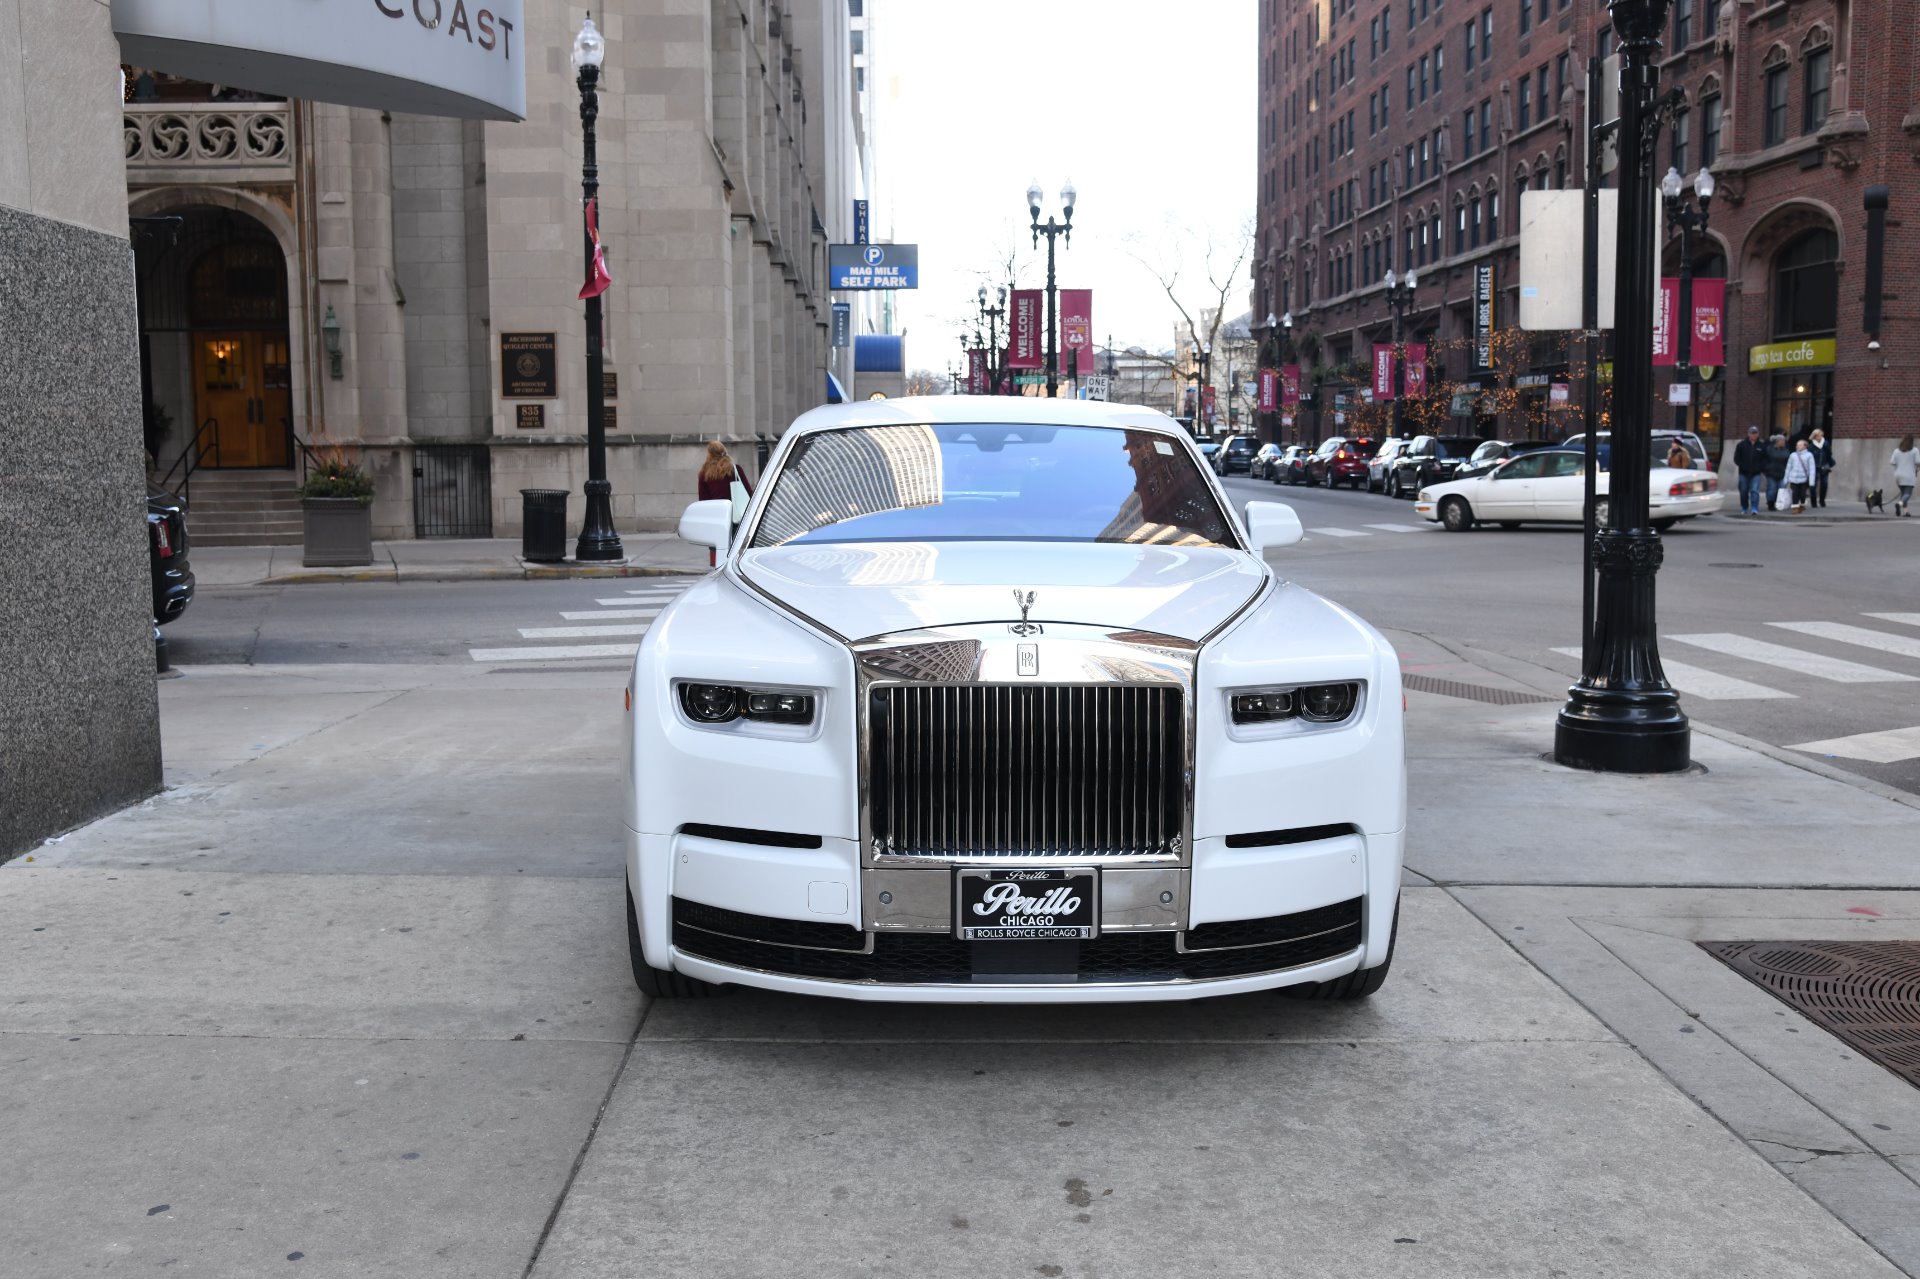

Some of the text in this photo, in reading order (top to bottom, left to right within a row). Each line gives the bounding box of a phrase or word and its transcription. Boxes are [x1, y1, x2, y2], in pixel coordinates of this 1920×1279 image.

[858, 202, 866, 244] GHIRA
[869, 249, 880, 262] P
[850, 267, 899, 275] MAG MILE
[841, 276, 907, 287] SELF PARK
[1480, 267, 1491, 300] BAGELS
[1018, 298, 1028, 358] WELCOME
[1786, 342, 1814, 361] café
[1089, 378, 1106, 386] ONE
[1088, 387, 1106, 395] WAY
[521, 406, 539, 416] 835
[1006, 871, 1049, 880] Perillo
[973, 882, 1081, 916] Perillo
[1000, 916, 1054, 926] CHICAGO
[977, 929, 1003, 938] ROLLS
[1006, 929, 1035, 938] ROYCE
[1038, 928, 1077, 937] CHICAGO
